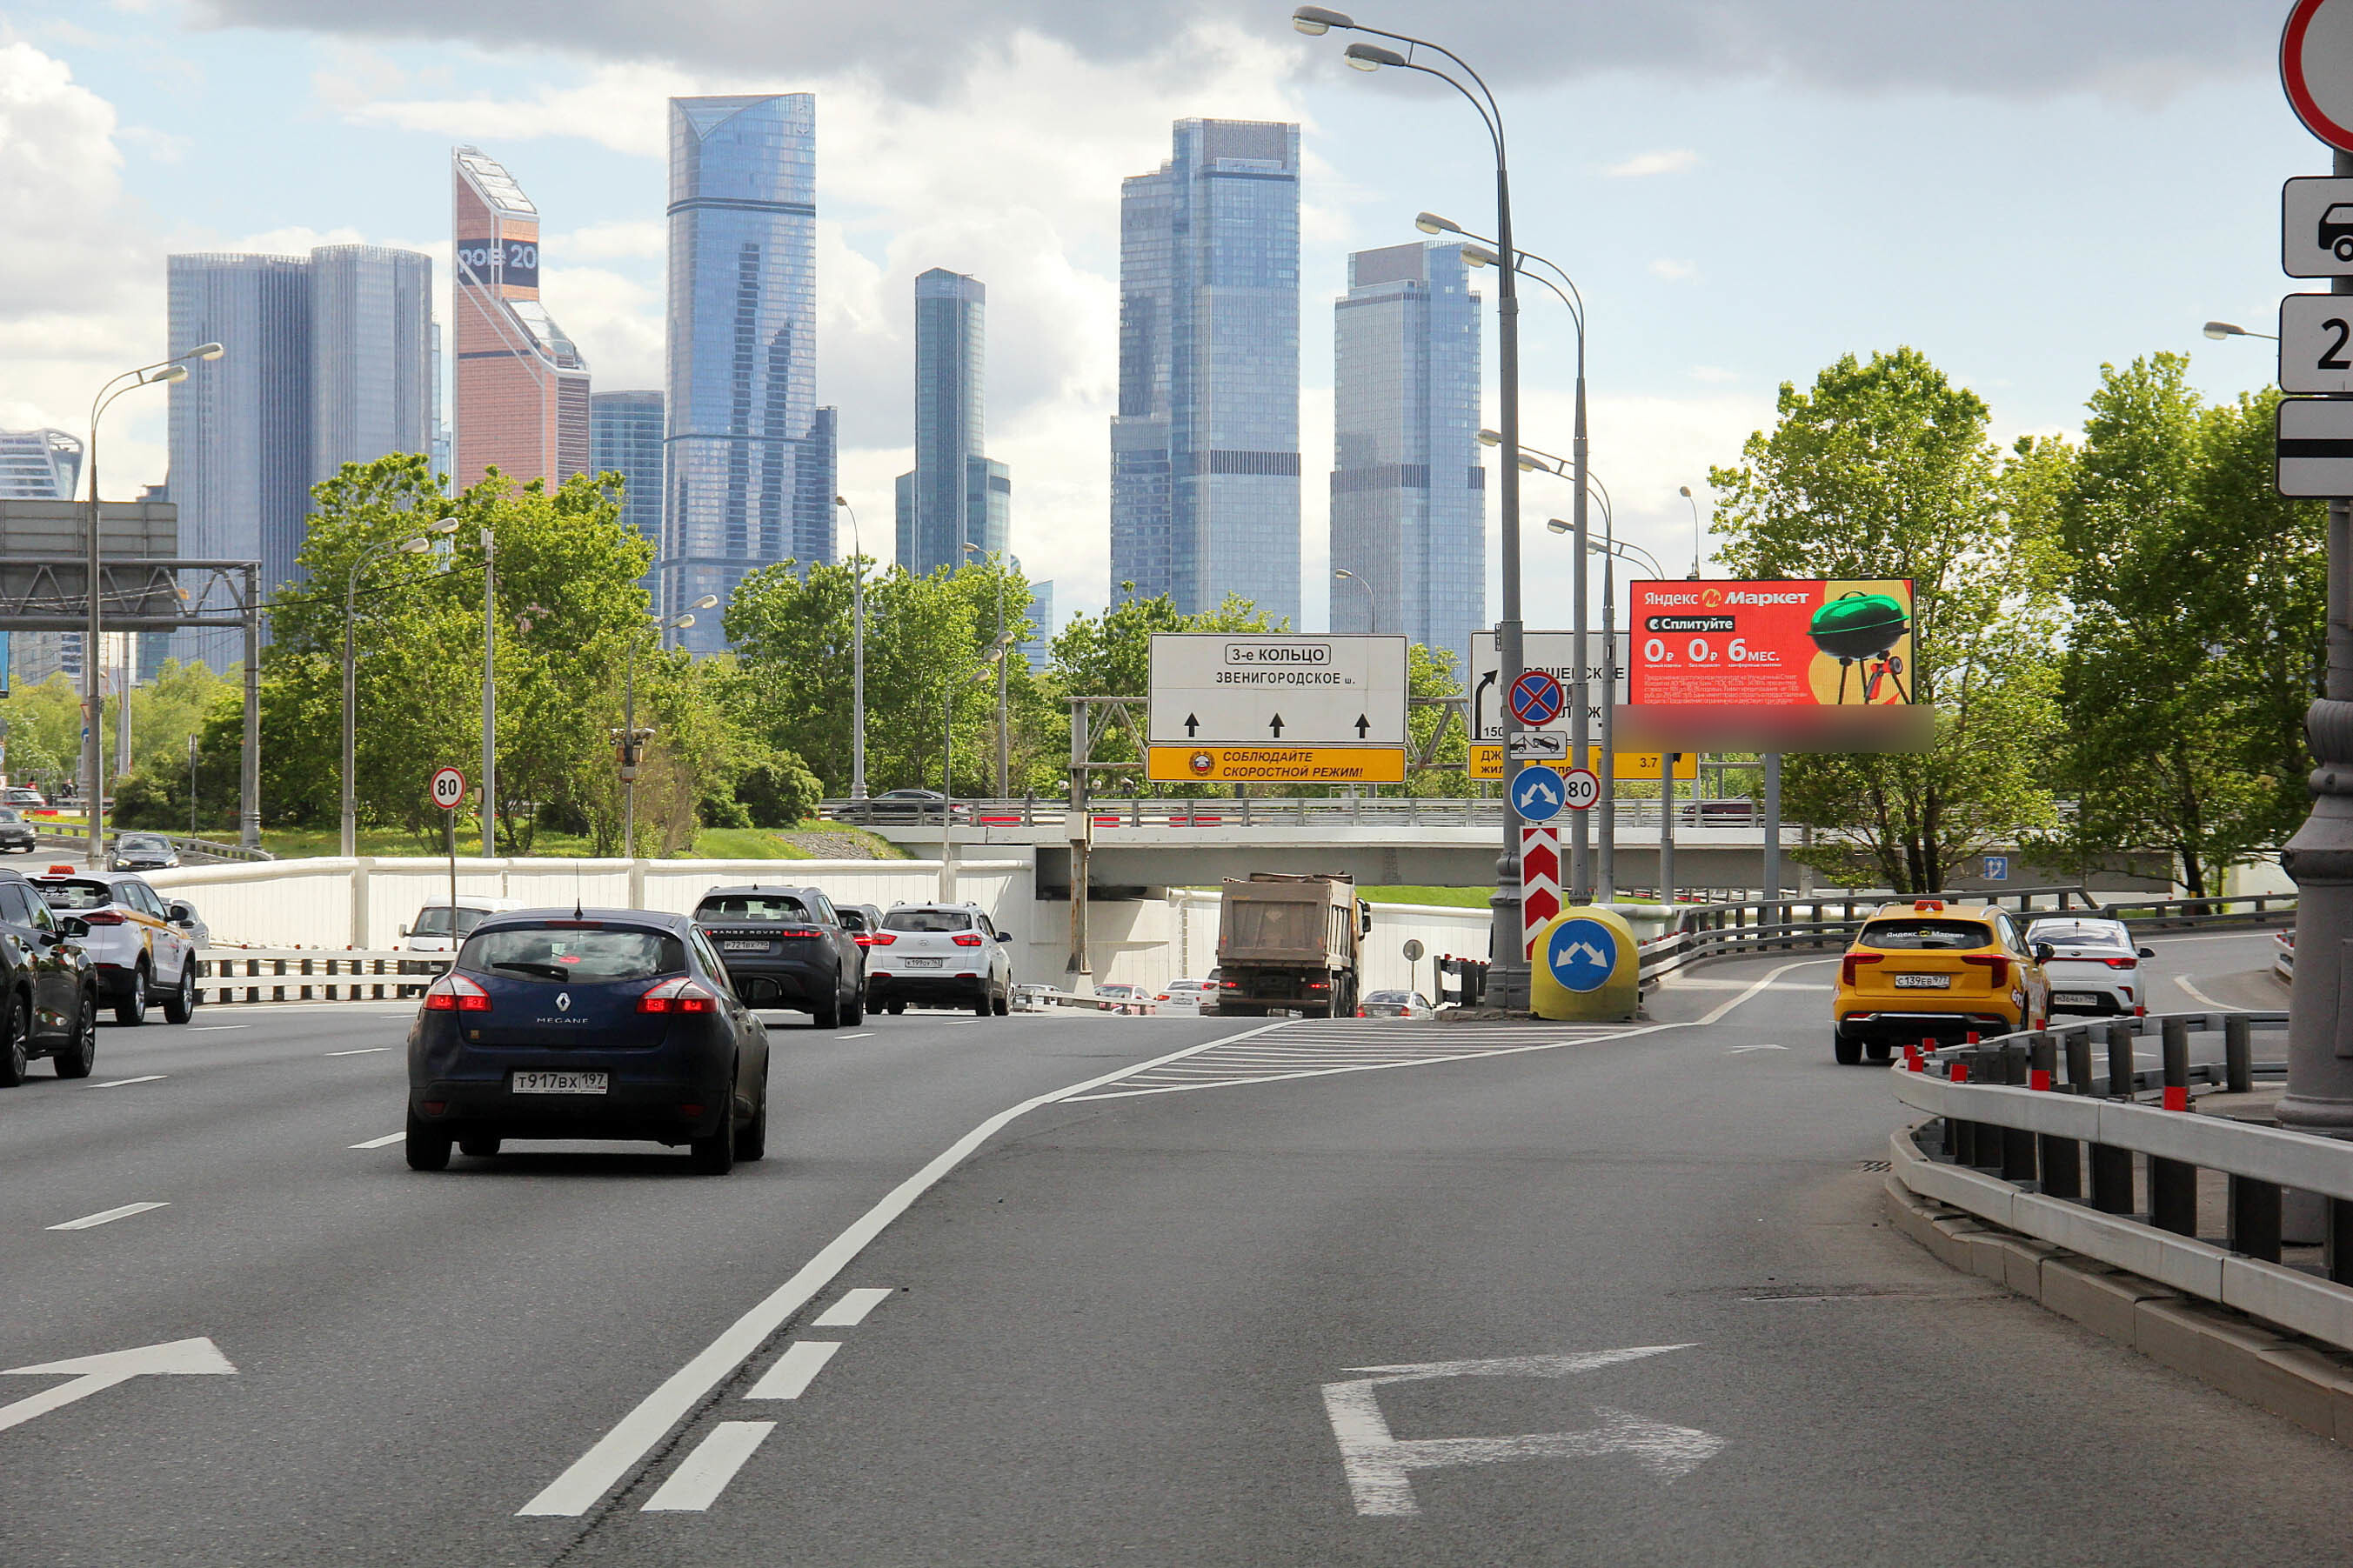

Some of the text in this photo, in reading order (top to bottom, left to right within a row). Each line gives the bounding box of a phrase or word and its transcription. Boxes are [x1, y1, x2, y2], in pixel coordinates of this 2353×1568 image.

[511, 244, 537, 269] 20
[1645, 591, 1809, 606] Яндекс Маркет
[1661, 618, 1734, 631] Сплитуйте
[1233, 648, 1324, 663] 3-е КОЛЬЦО
[1216, 672, 1340, 685] ЗВЕНИГОРОДСКОЕ
[1223, 751, 1314, 764] СОБЛЮДАЙТЕ
[1640, 757, 1657, 768] 3.7
[1223, 765, 1363, 778] СКОРОСТНОЙ РЕЖИМ!
[438, 778, 457, 796] 80
[1568, 781, 1591, 797] 80
[582, 1073, 605, 1084] 197
